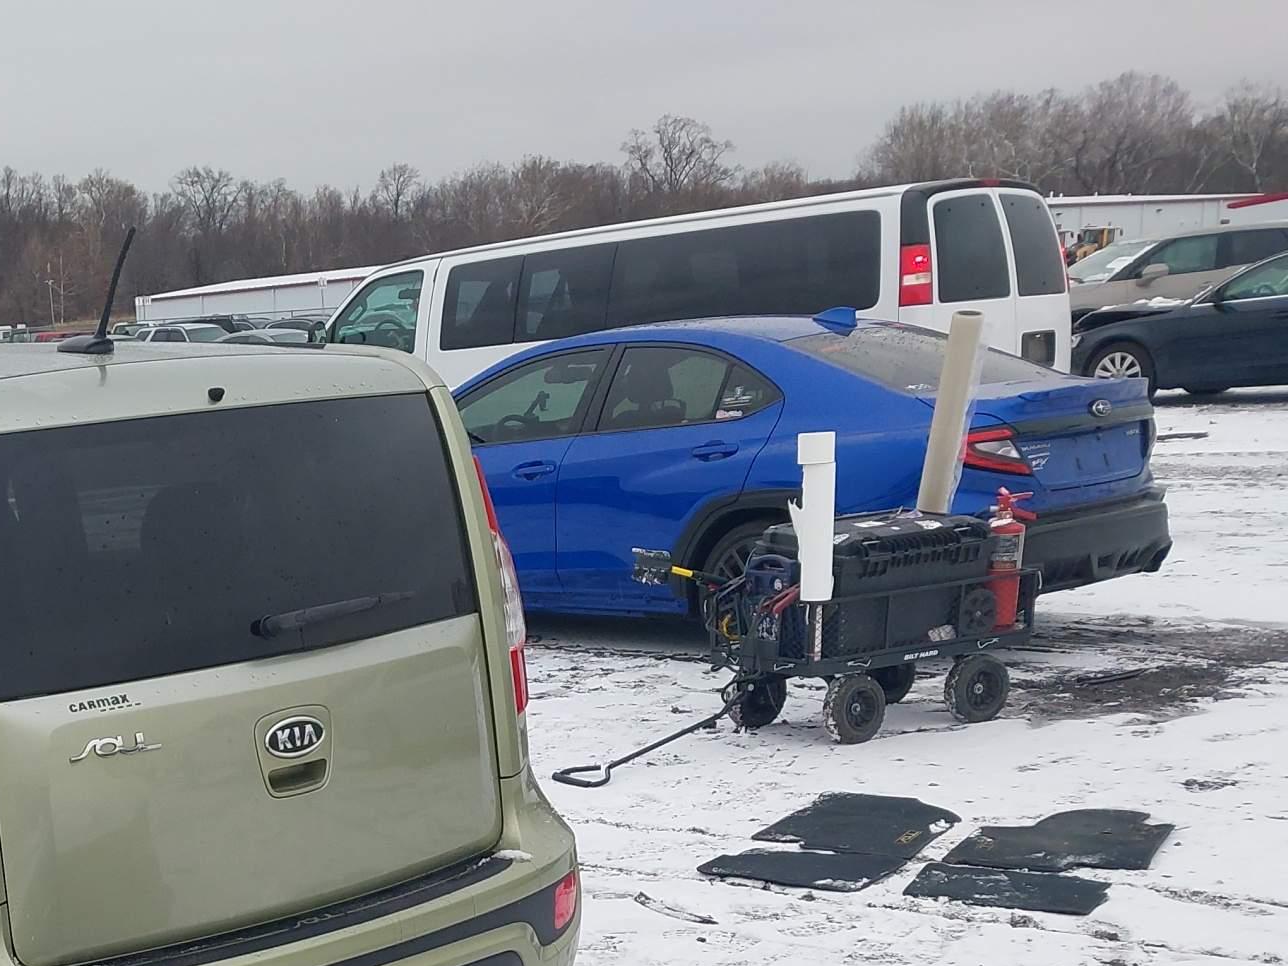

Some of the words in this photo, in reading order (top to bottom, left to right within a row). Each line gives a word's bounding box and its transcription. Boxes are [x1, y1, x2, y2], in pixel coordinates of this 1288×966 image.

[919, 650, 939, 659] HARD
[69, 732, 162, 763] SOUL
[275, 723, 318, 751] KIA
